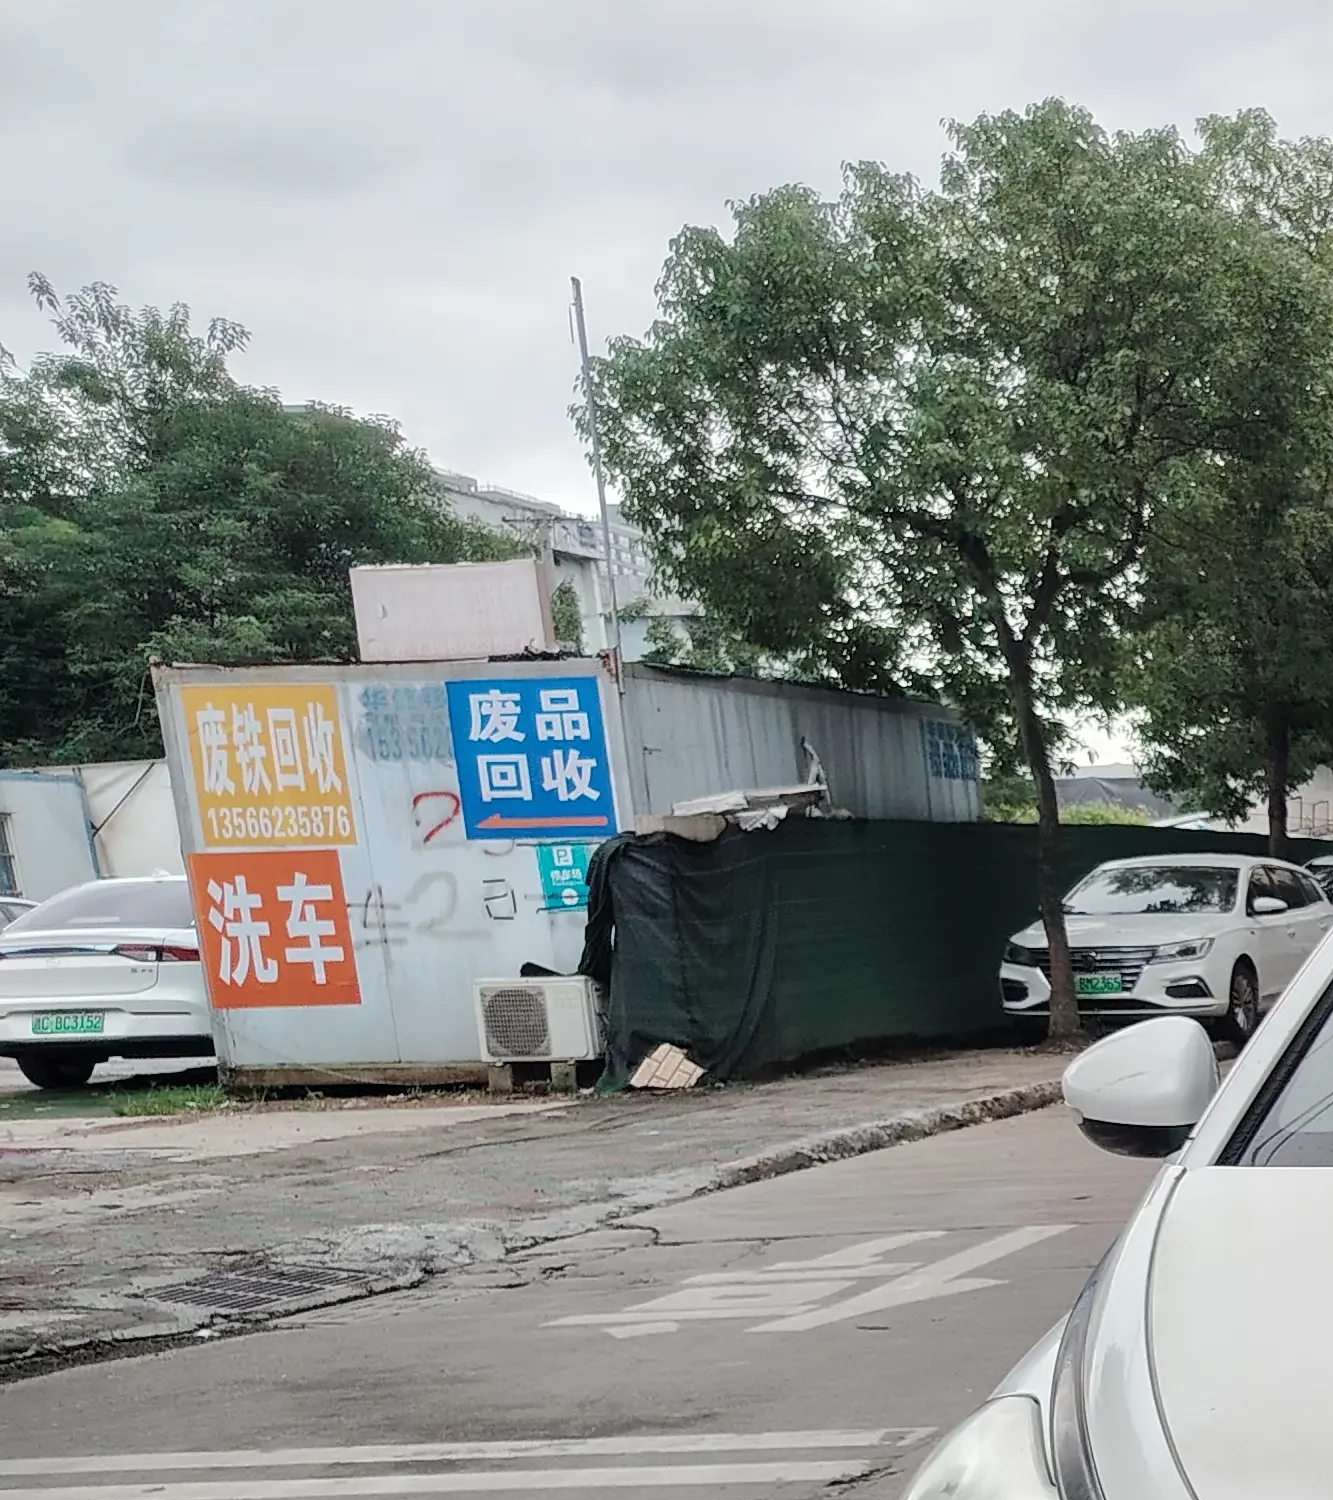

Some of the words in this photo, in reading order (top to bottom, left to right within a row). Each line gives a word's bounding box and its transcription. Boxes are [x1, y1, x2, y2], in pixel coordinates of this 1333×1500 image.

[468, 688, 591, 744] 废品
[196, 701, 342, 796] 废铁回收
[476, 747, 601, 802] 回收
[207, 804, 350, 840] 13566235876
[207, 872, 345, 987] 洗车
